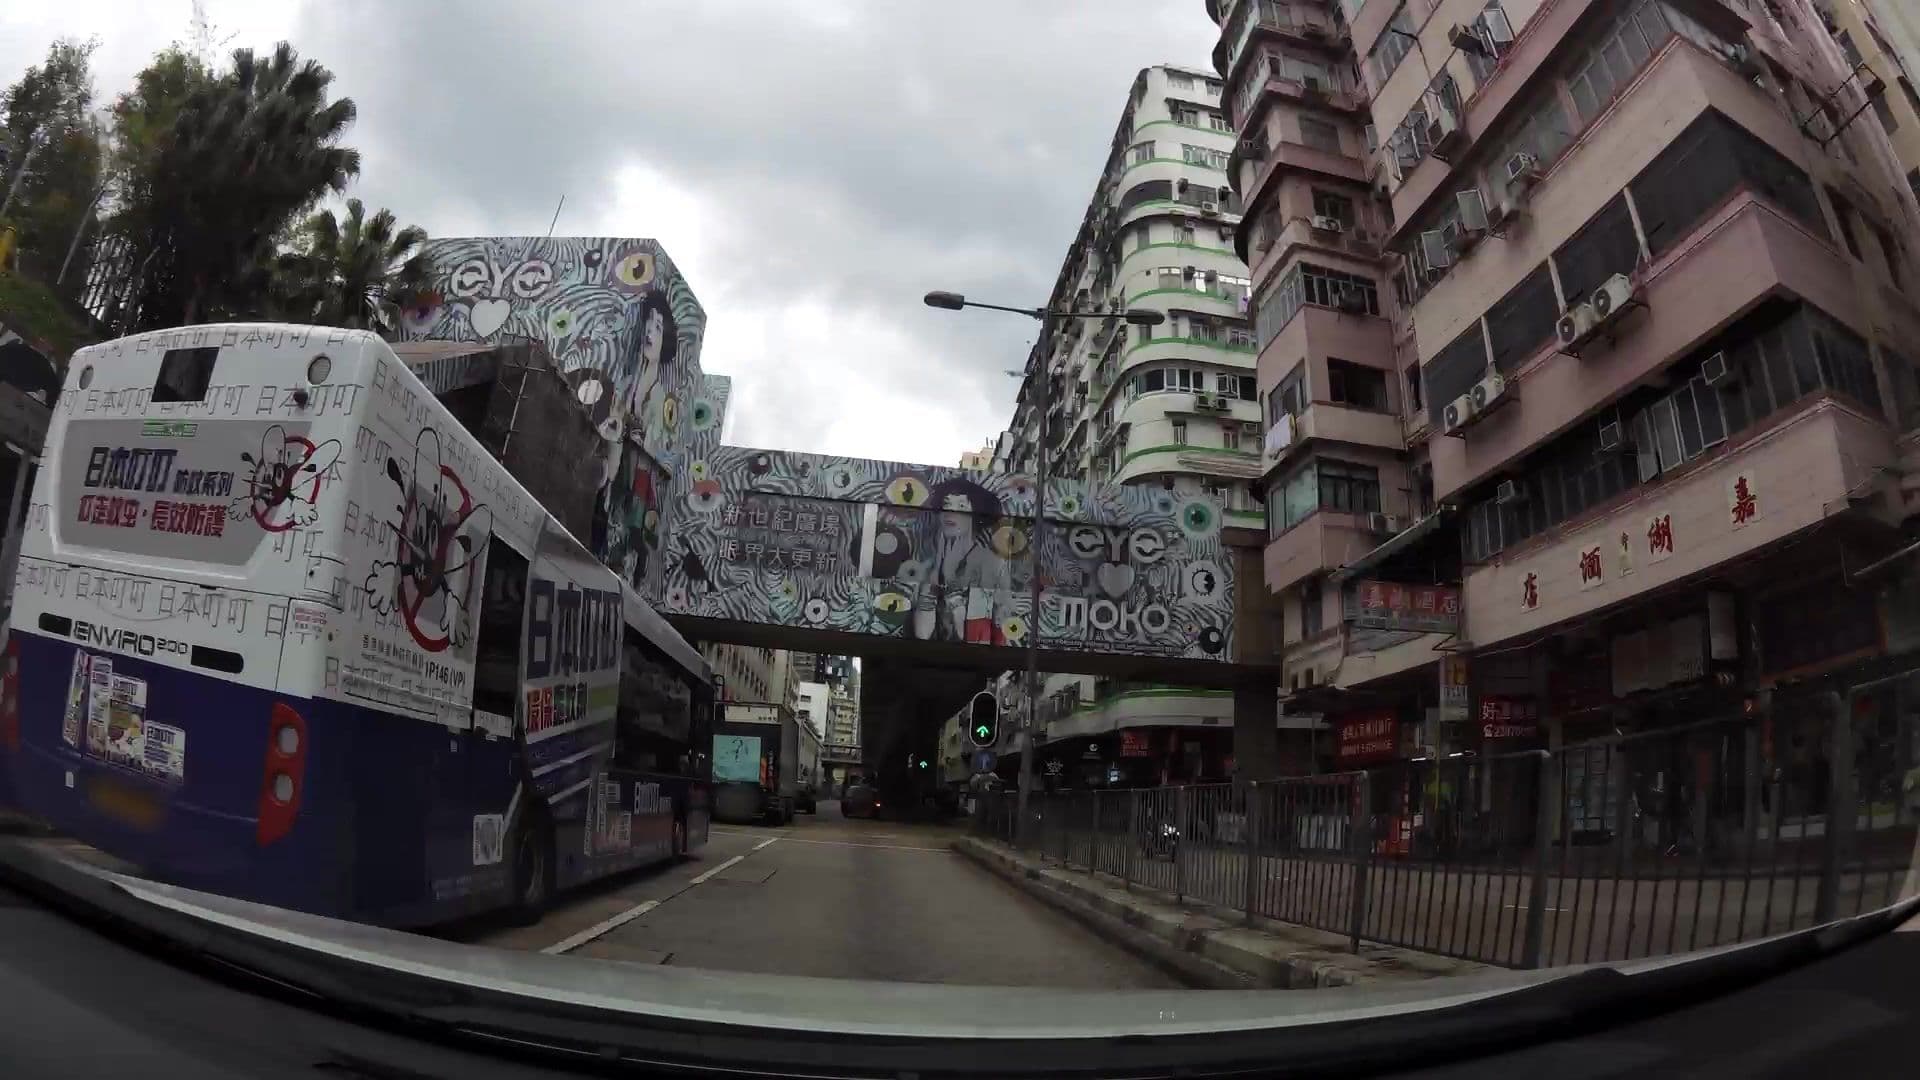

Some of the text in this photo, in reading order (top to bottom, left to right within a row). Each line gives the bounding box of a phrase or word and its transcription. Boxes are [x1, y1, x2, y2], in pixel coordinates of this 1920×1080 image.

[256, 384, 365, 417] 日本叮叮
[84, 447, 178, 492] 日本叮叮
[722, 503, 842, 537] 新世紀廣場
[158, 582, 253, 635] 日本叮叮
